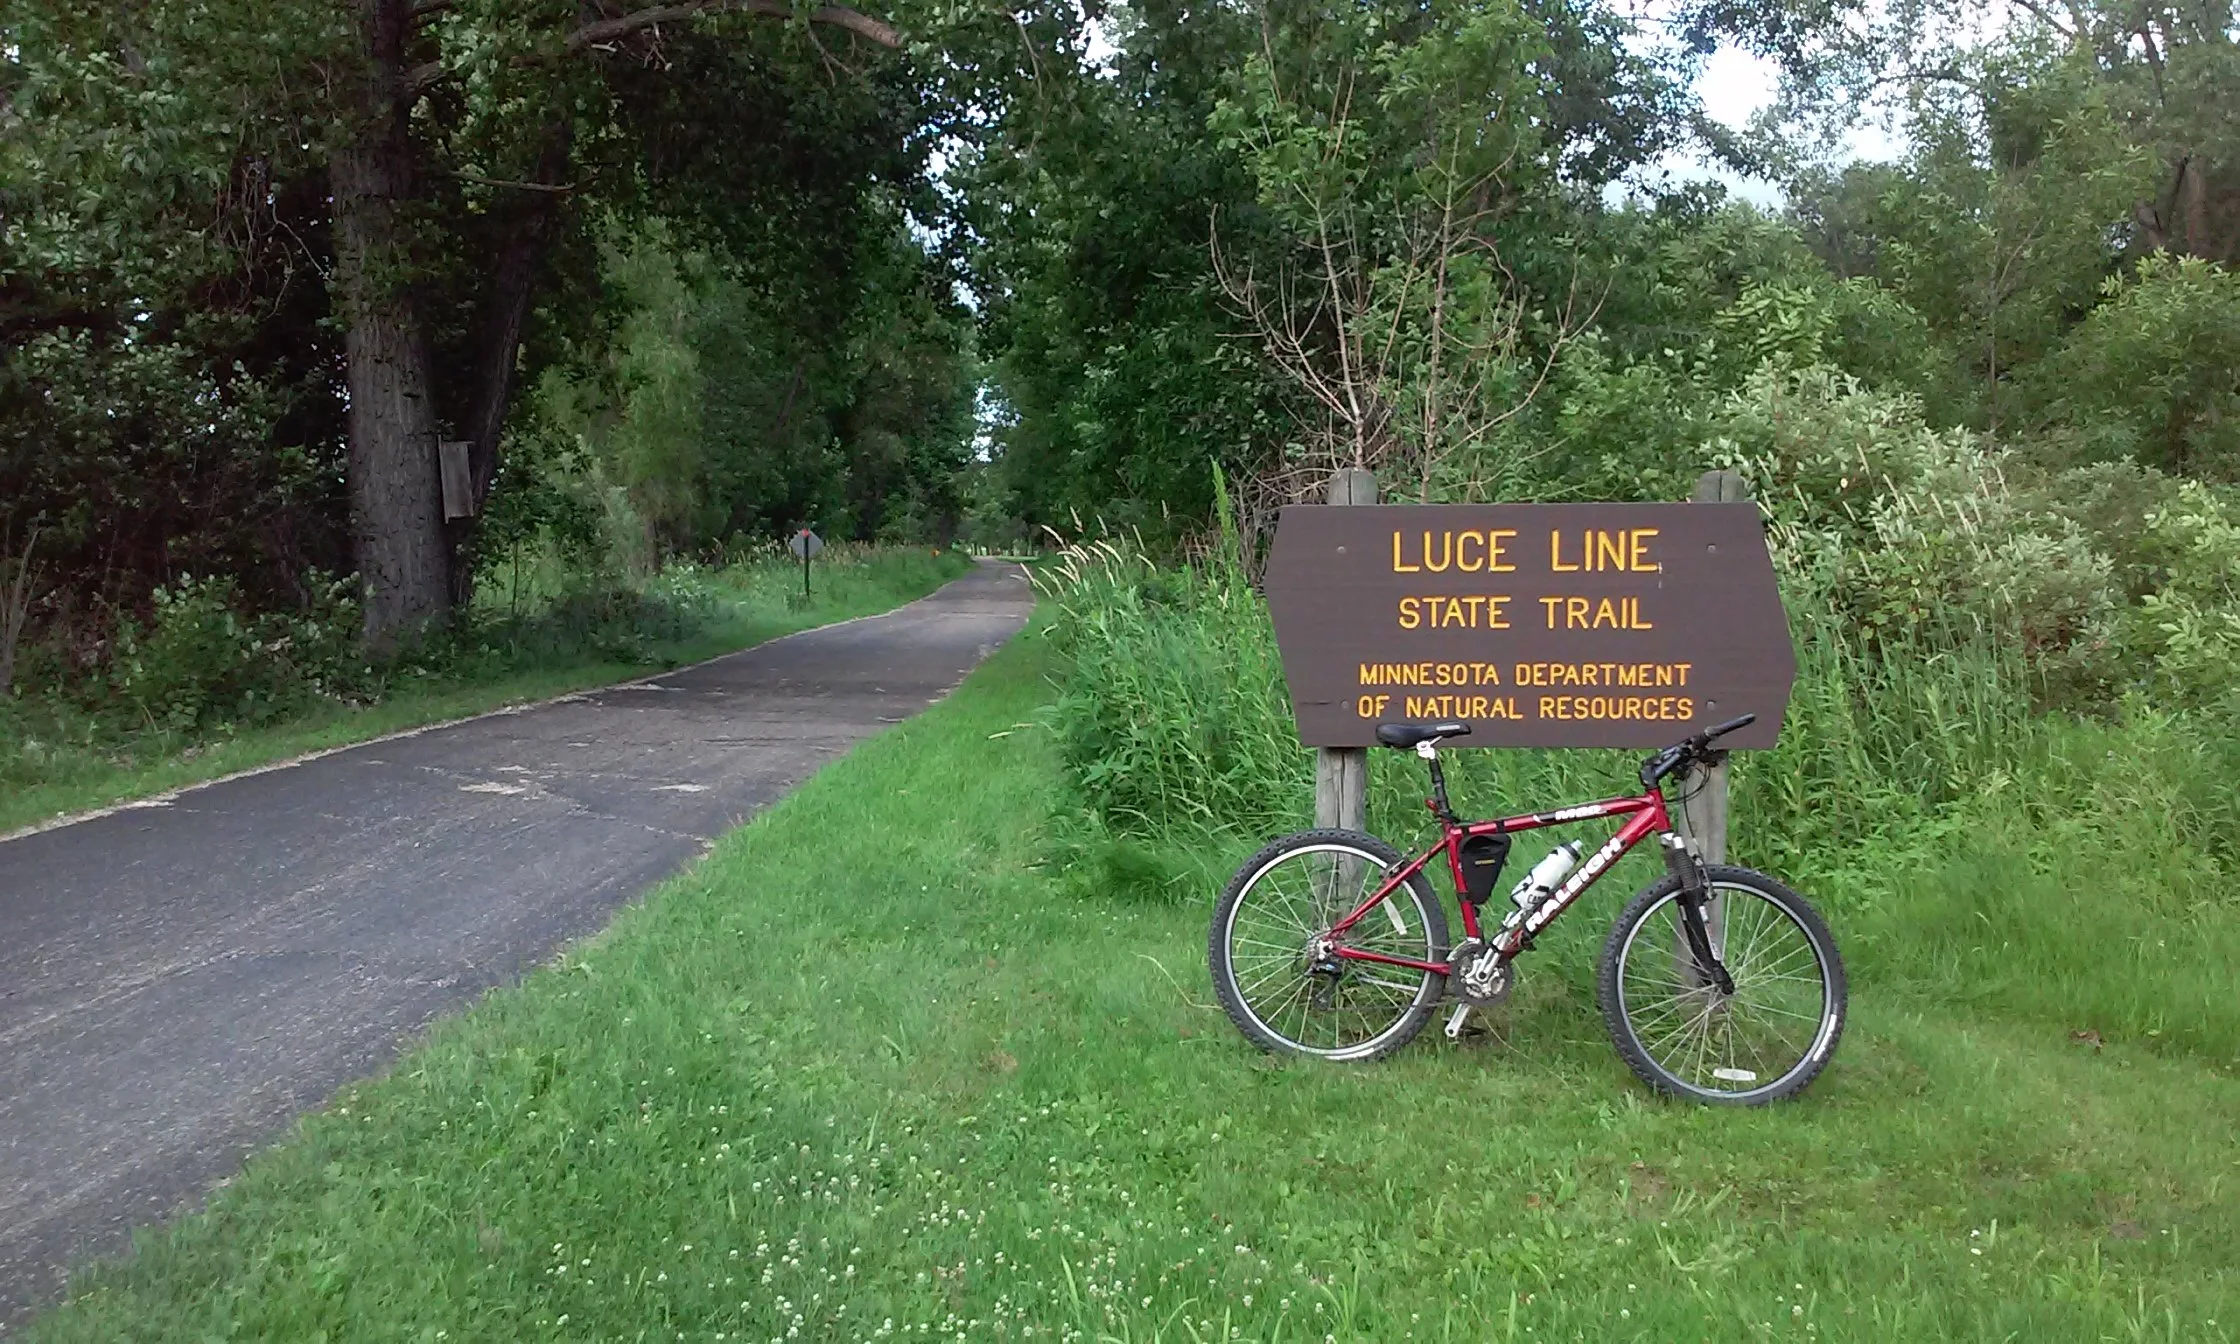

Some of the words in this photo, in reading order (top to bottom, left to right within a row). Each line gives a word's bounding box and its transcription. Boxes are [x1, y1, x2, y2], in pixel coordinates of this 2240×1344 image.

[1393, 529, 1518, 573] LUCE
[1551, 529, 1659, 572] LINE
[1398, 596, 1511, 629] STATE
[1539, 597, 1653, 630] TRAIL
[1359, 662, 1500, 687] MINNESOTA
[1515, 662, 1693, 687] DEPARTMENT
[1358, 695, 1390, 719] OF
[1405, 695, 1525, 720] NATURAL
[1539, 695, 1694, 721] RESOURCES
[1525, 837, 1621, 932] RALEIGH
